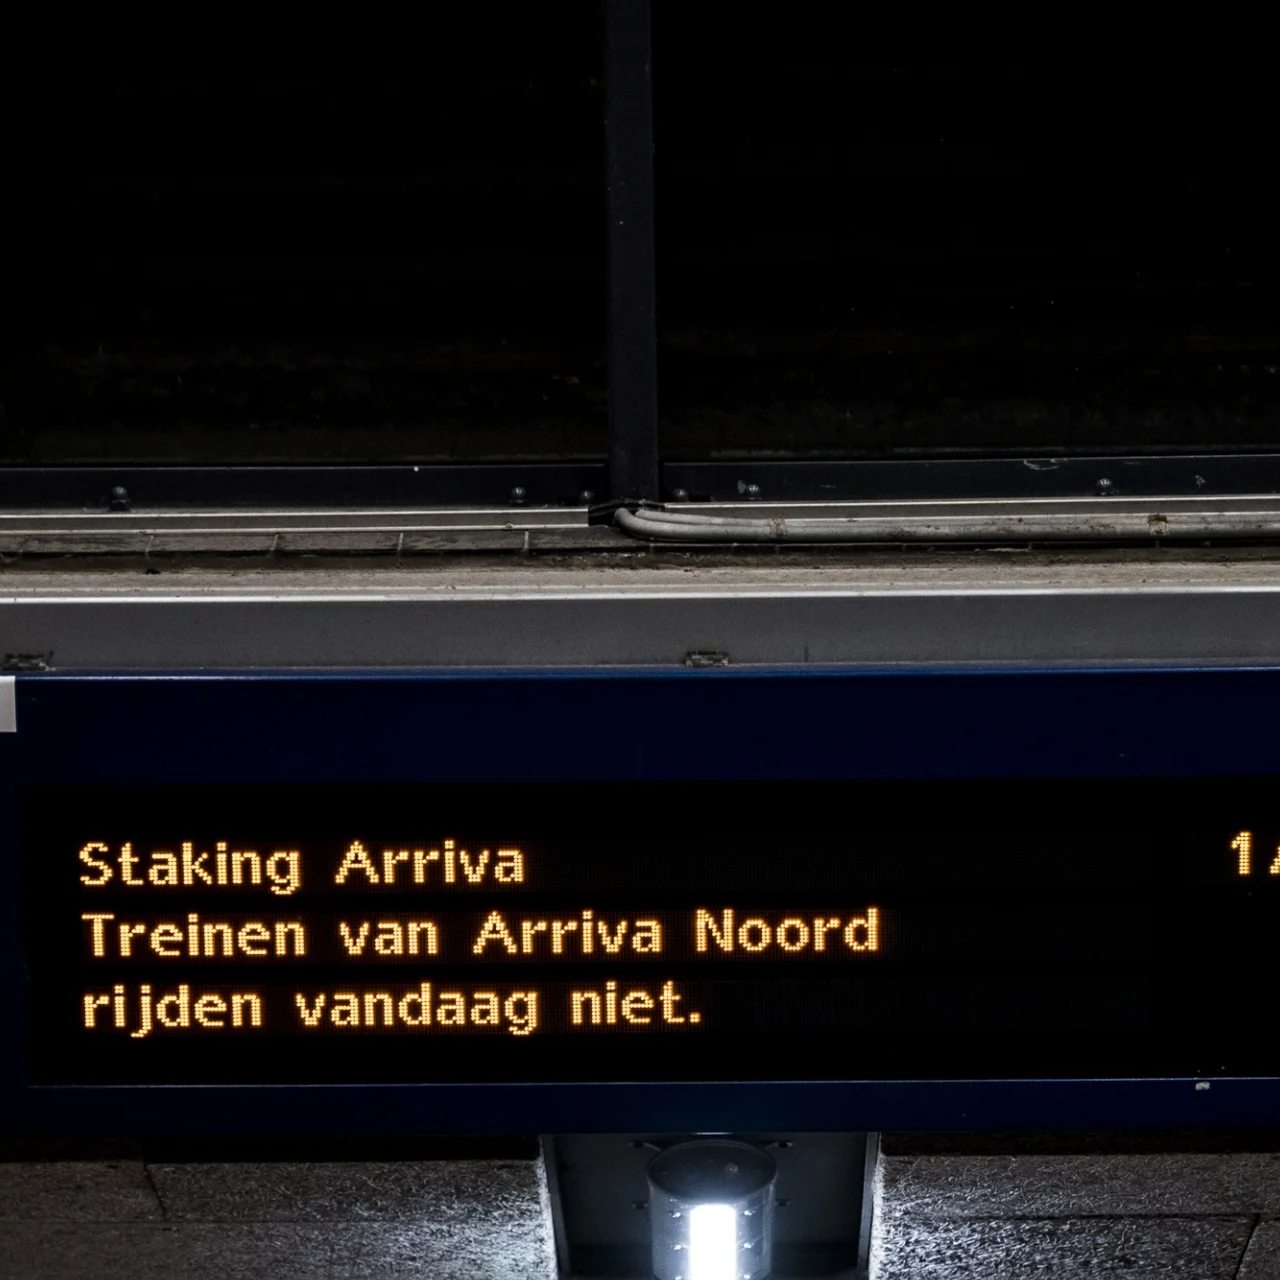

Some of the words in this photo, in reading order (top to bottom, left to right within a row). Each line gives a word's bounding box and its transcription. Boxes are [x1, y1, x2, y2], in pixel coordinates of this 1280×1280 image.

[78, 840, 302, 896] Staking
[333, 838, 526, 885] Arriva
[80, 912, 306, 958] Treinen
[338, 920, 440, 957] van
[471, 908, 663, 955] Arriva
[694, 906, 880, 953] Noord
[82, 983, 263, 1039] rijden
[294, 981, 539, 1037] vandaag
[570, 979, 702, 1026] niet.
